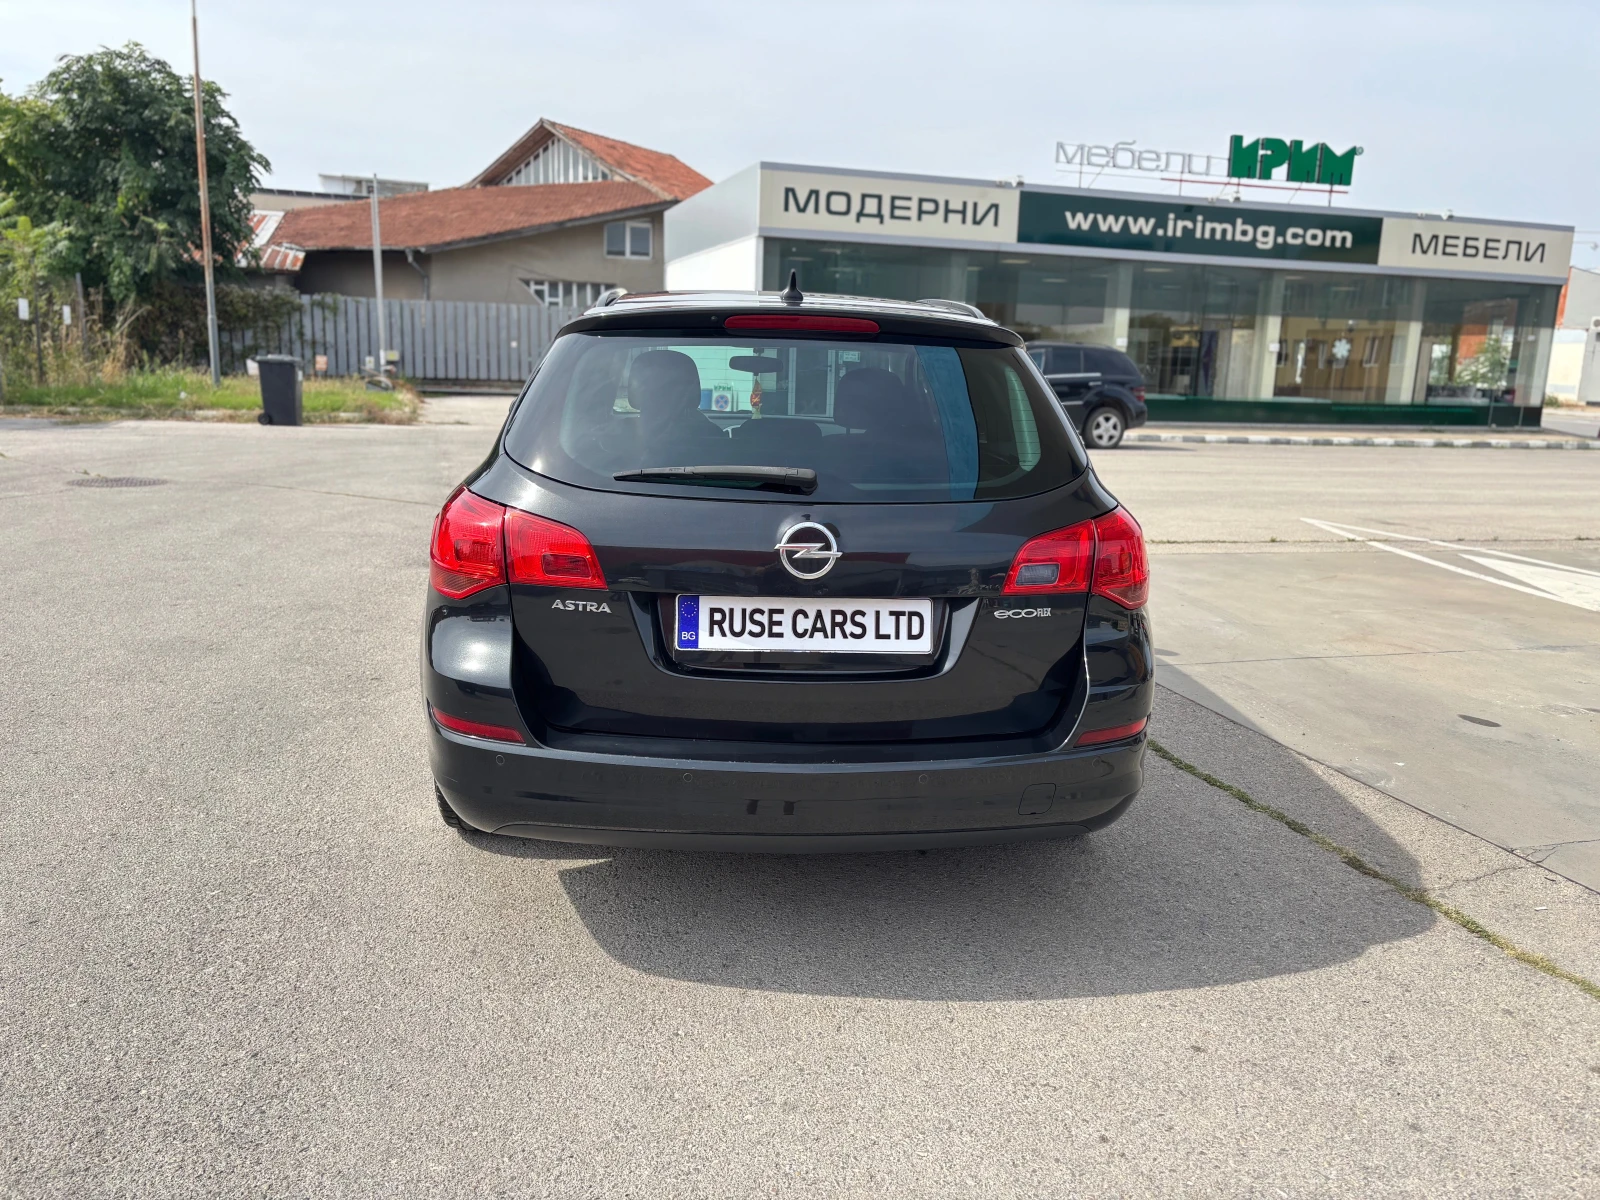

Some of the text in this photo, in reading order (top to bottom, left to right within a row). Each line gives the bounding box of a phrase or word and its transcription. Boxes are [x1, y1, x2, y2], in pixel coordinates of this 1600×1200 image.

[1228, 134, 1356, 186] ИРИМ
[783, 186, 1000, 227] МОДЕРНИ
[1064, 210, 1354, 250] www.irimbg.com
[1411, 233, 1546, 263] МЕБЕЛИ
[551, 599, 613, 614] ASTRA
[681, 631, 696, 641] BG
[708, 607, 925, 641] RUSE CARS LTD
